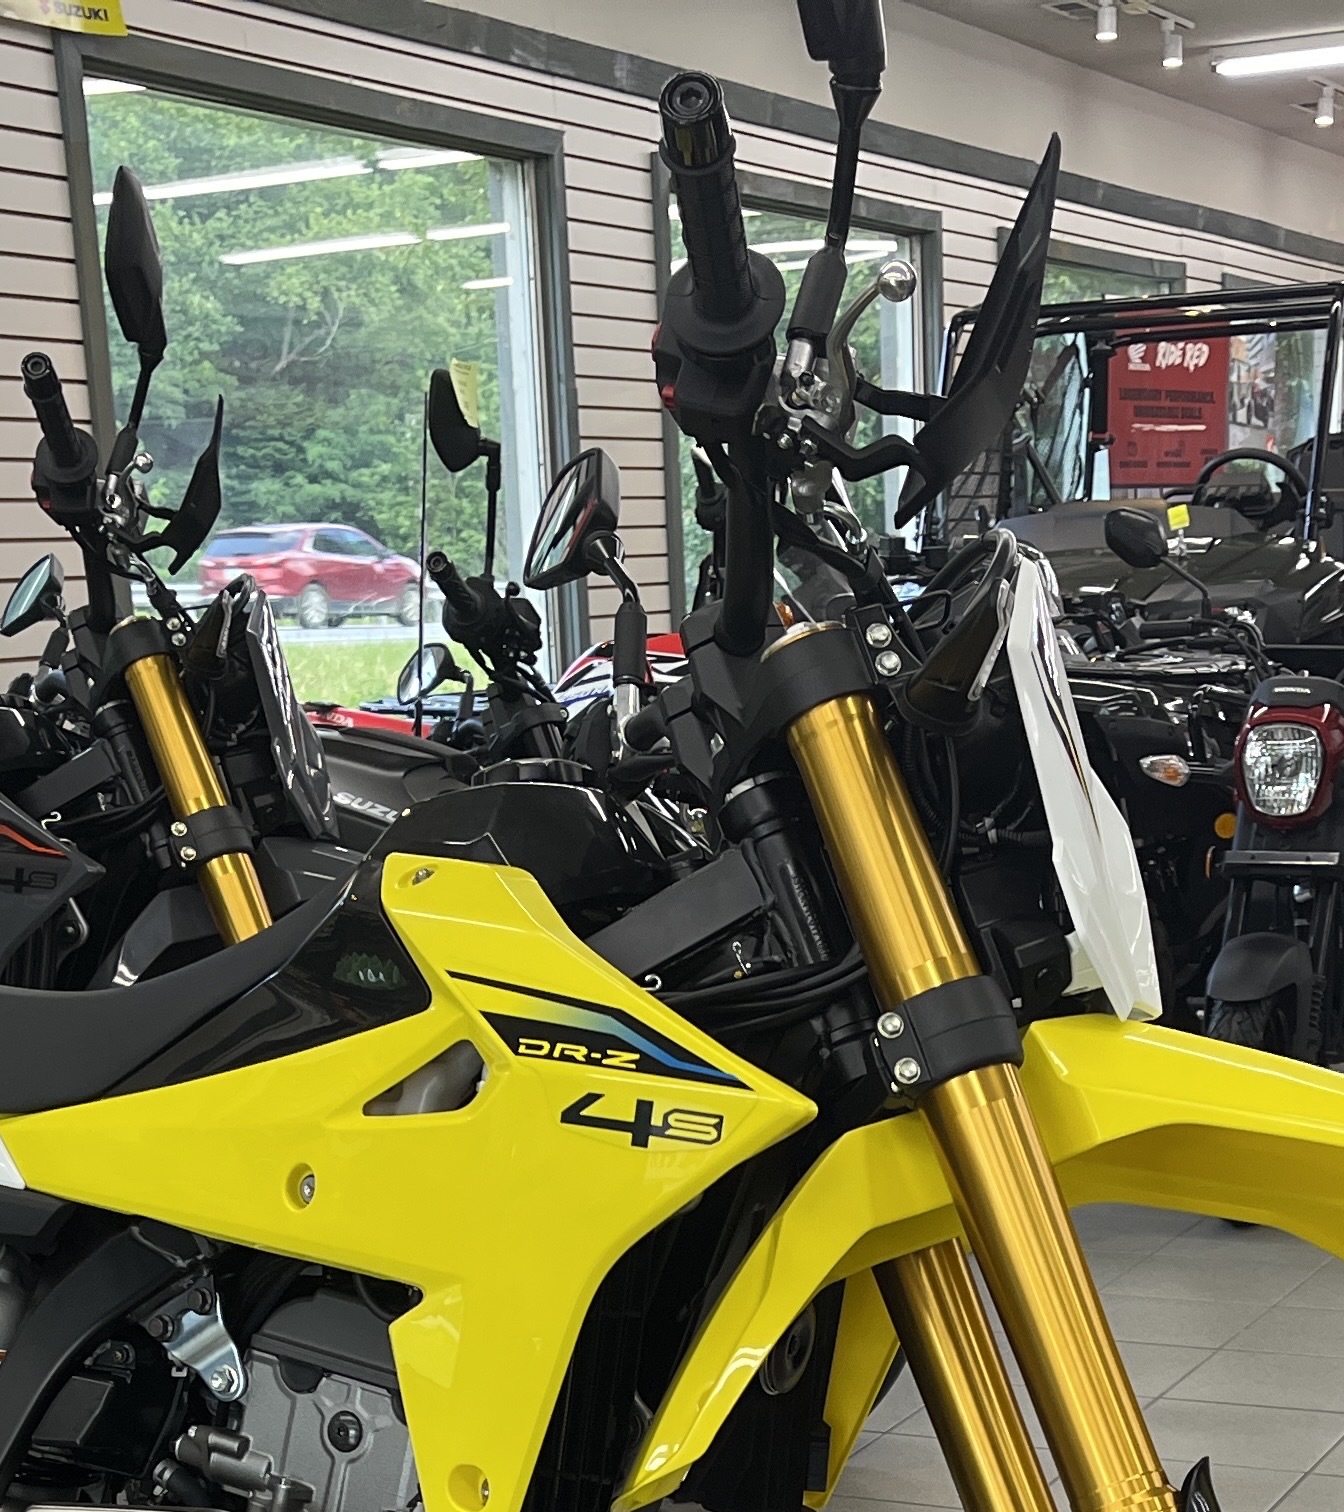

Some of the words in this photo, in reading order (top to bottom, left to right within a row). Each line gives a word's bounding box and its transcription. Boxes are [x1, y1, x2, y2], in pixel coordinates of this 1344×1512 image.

[56, 3, 110, 21] SUZUKI
[517, 1037, 641, 1069] DR-Z
[559, 1091, 724, 1148] 4S
